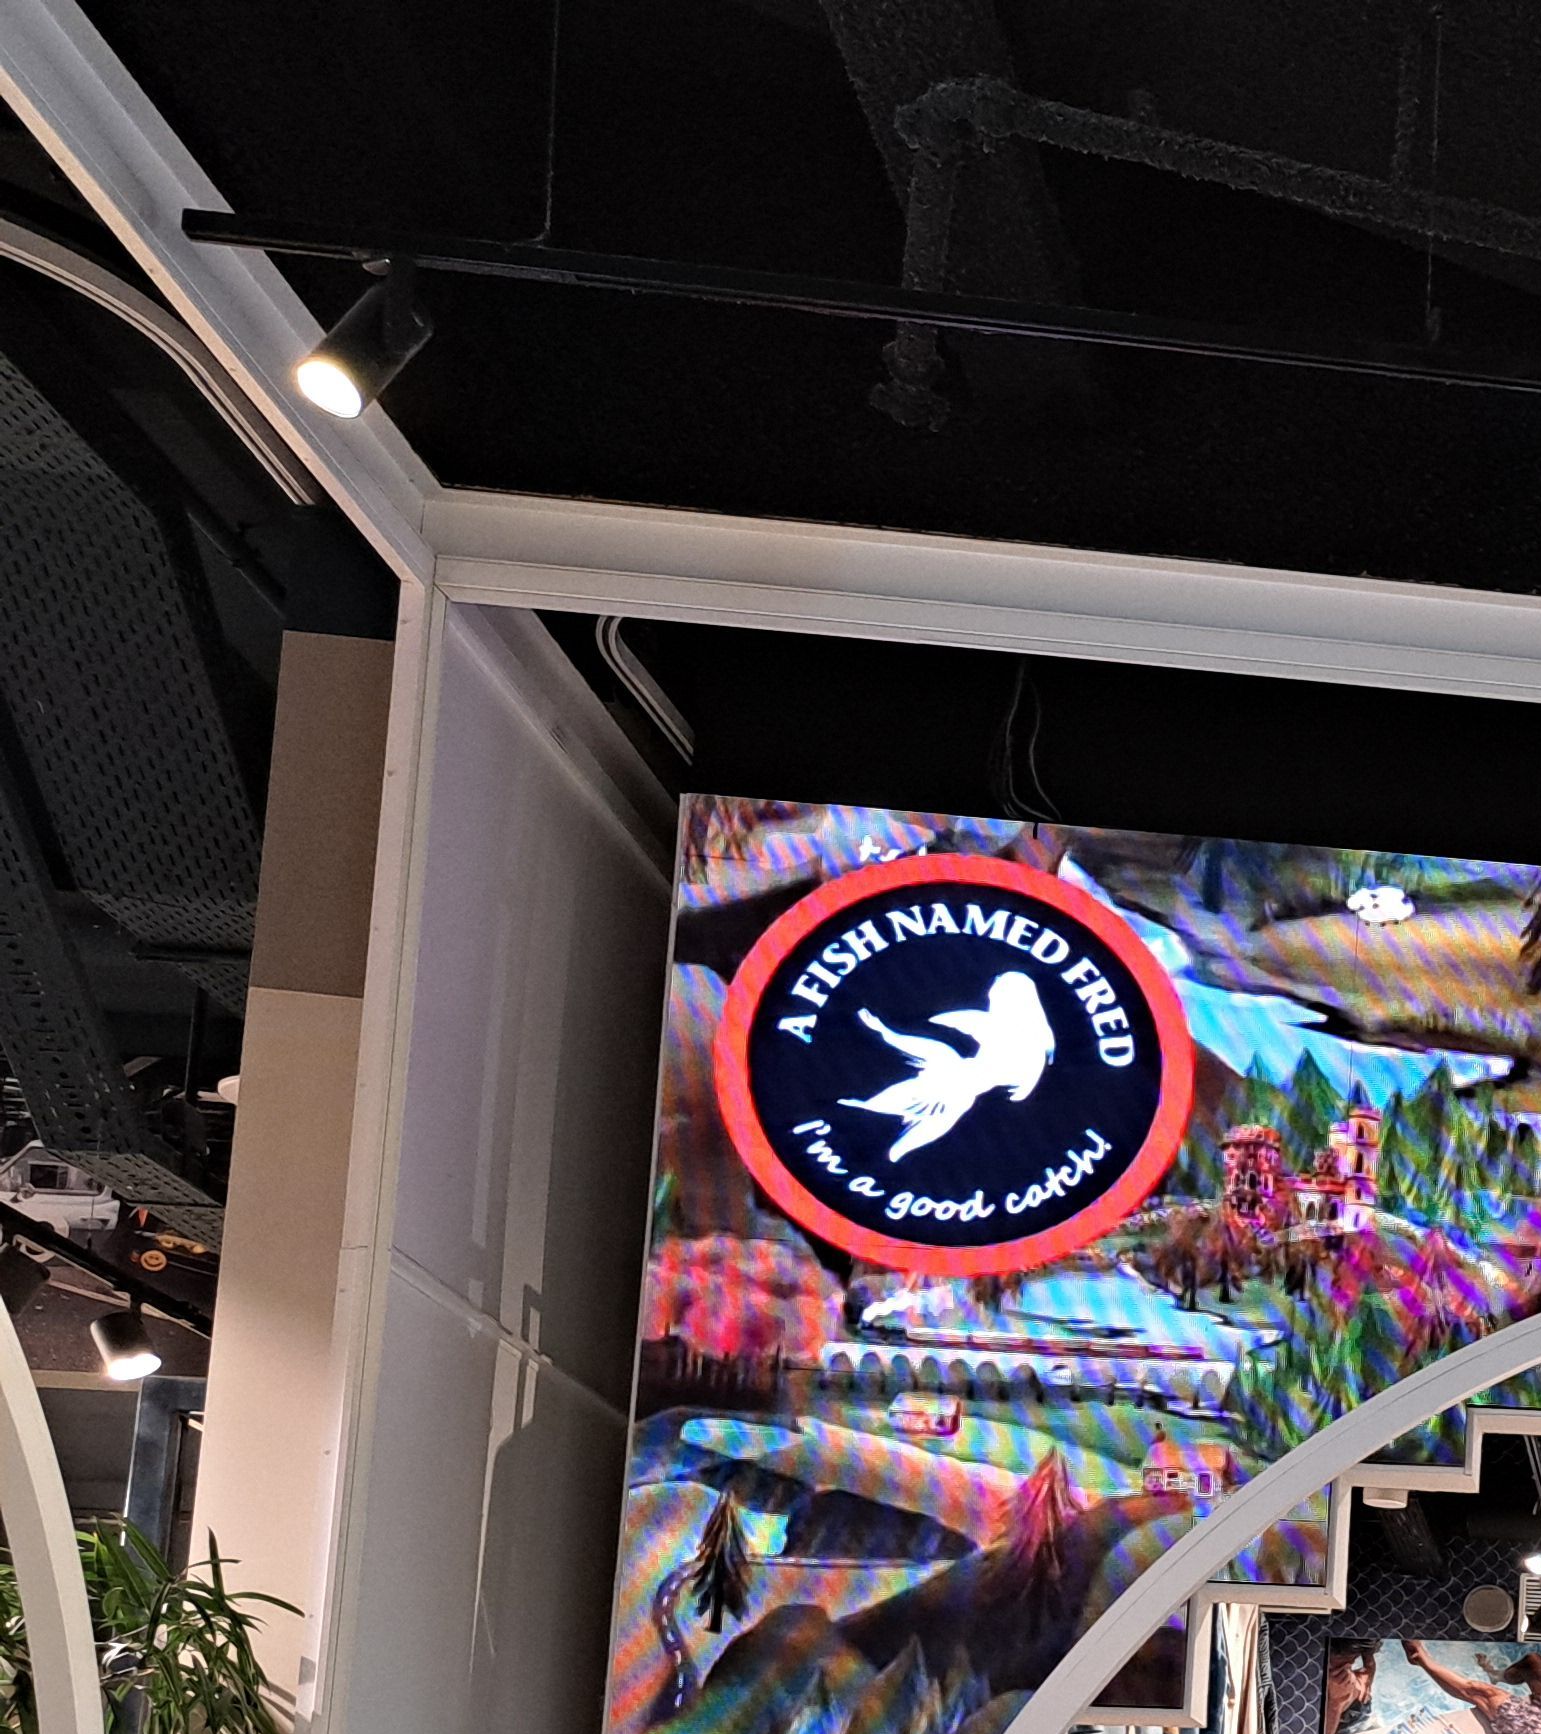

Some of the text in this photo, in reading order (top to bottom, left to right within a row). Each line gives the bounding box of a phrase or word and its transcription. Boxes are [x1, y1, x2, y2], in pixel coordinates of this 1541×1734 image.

[778, 903, 1135, 1067] A FISH NAMED FRED
[792, 1118, 1114, 1222] I'm a good catch!
